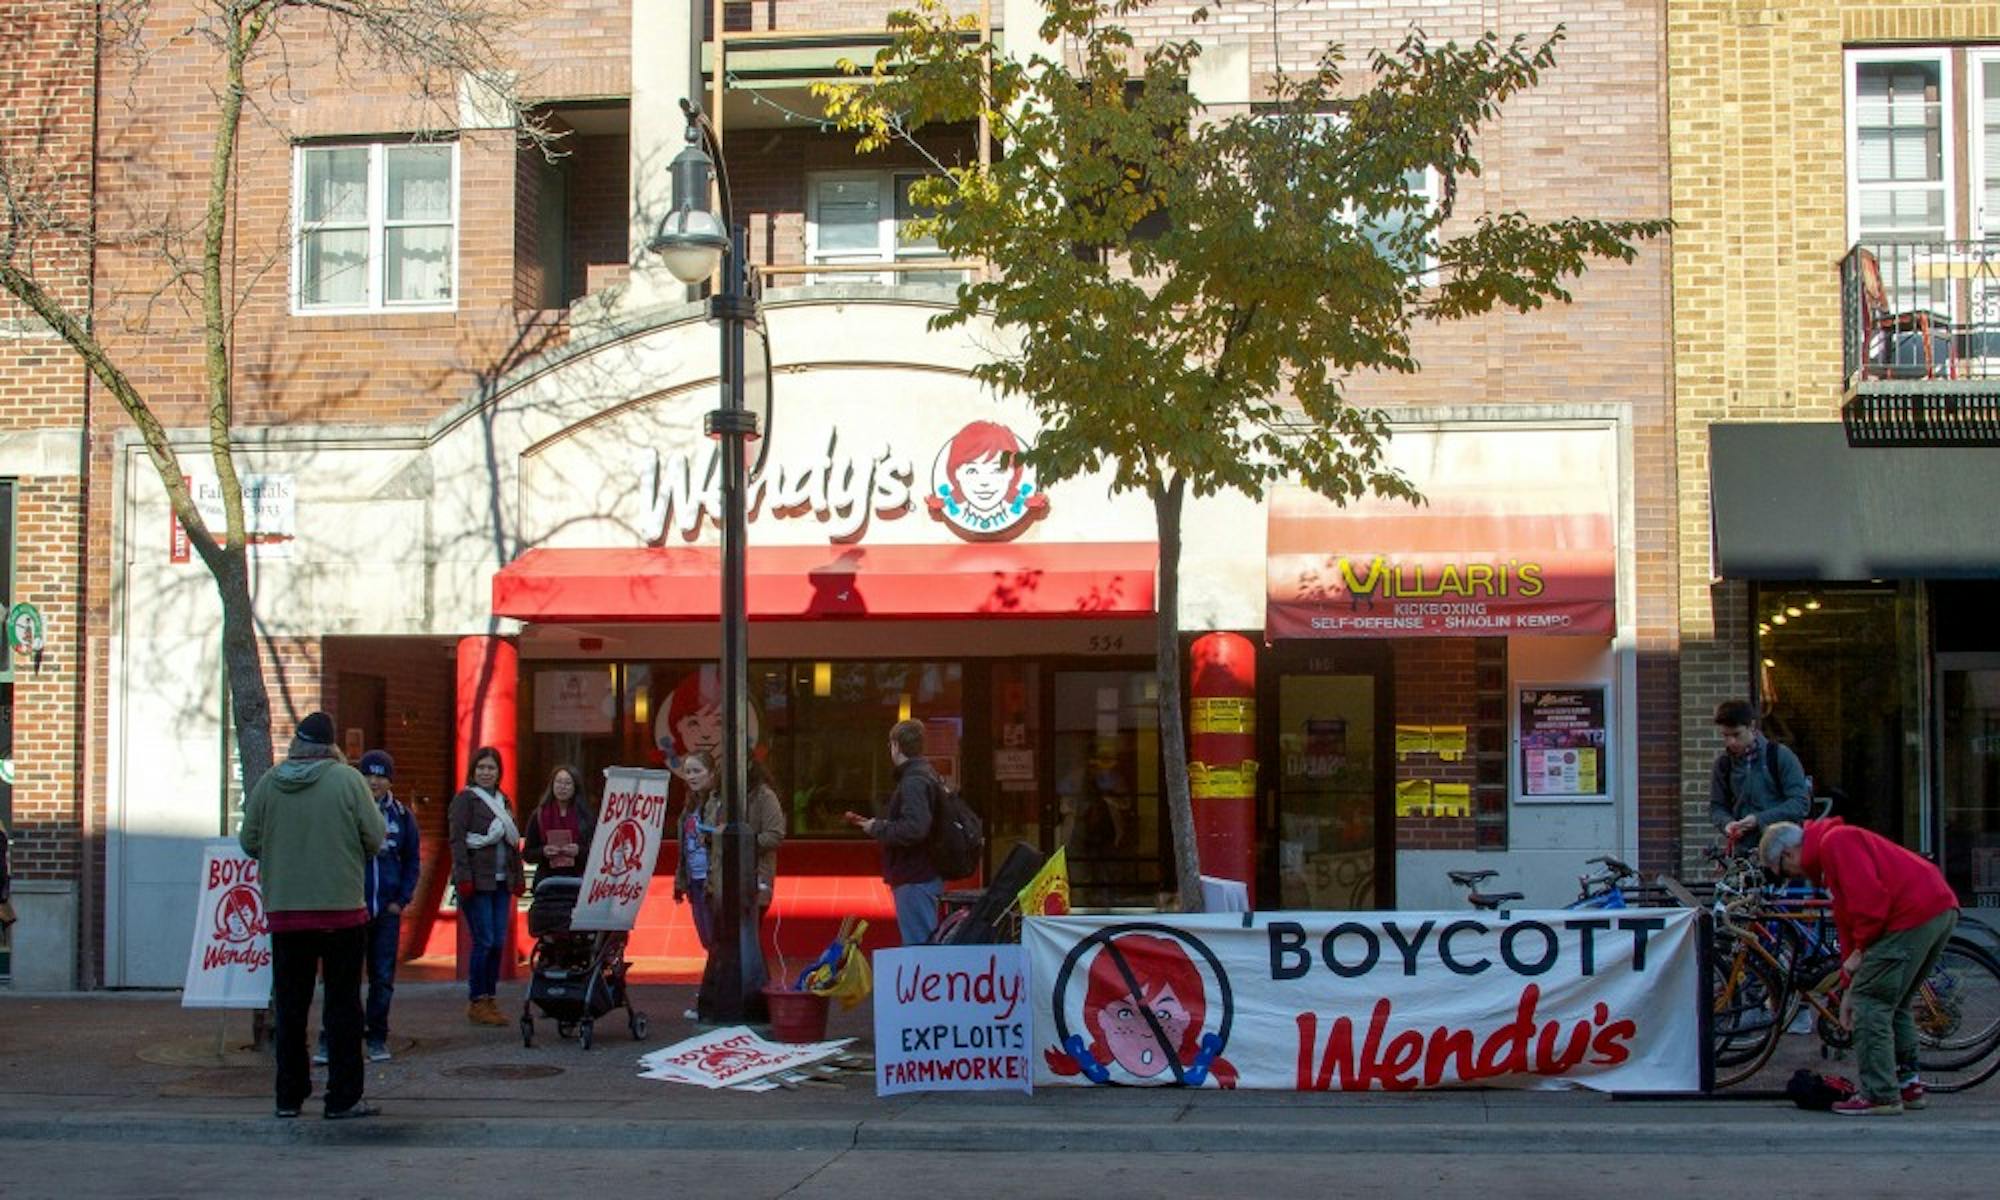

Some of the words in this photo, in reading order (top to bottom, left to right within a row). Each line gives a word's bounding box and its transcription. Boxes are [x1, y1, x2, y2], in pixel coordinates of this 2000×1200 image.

[242, 481, 289, 499] entals
[1310, 616, 1424, 630] SELF-DEFENSE
[1444, 615, 1512, 629] SHAOLIN
[1516, 614, 1571, 628] KEMPO
[1395, 602, 1487, 616] KICKBOXING
[1089, 635, 1123, 650] 534
[602, 791, 665, 829] BOYCOTT
[208, 859, 262, 890] BOYC
[587, 874, 643, 906] Wendy's
[203, 940, 271, 973] Wendy's
[1267, 917, 1666, 981] BOYCOTT
[896, 953, 1025, 1020] Wendy
[901, 1023, 1025, 1052] EXPLOITS
